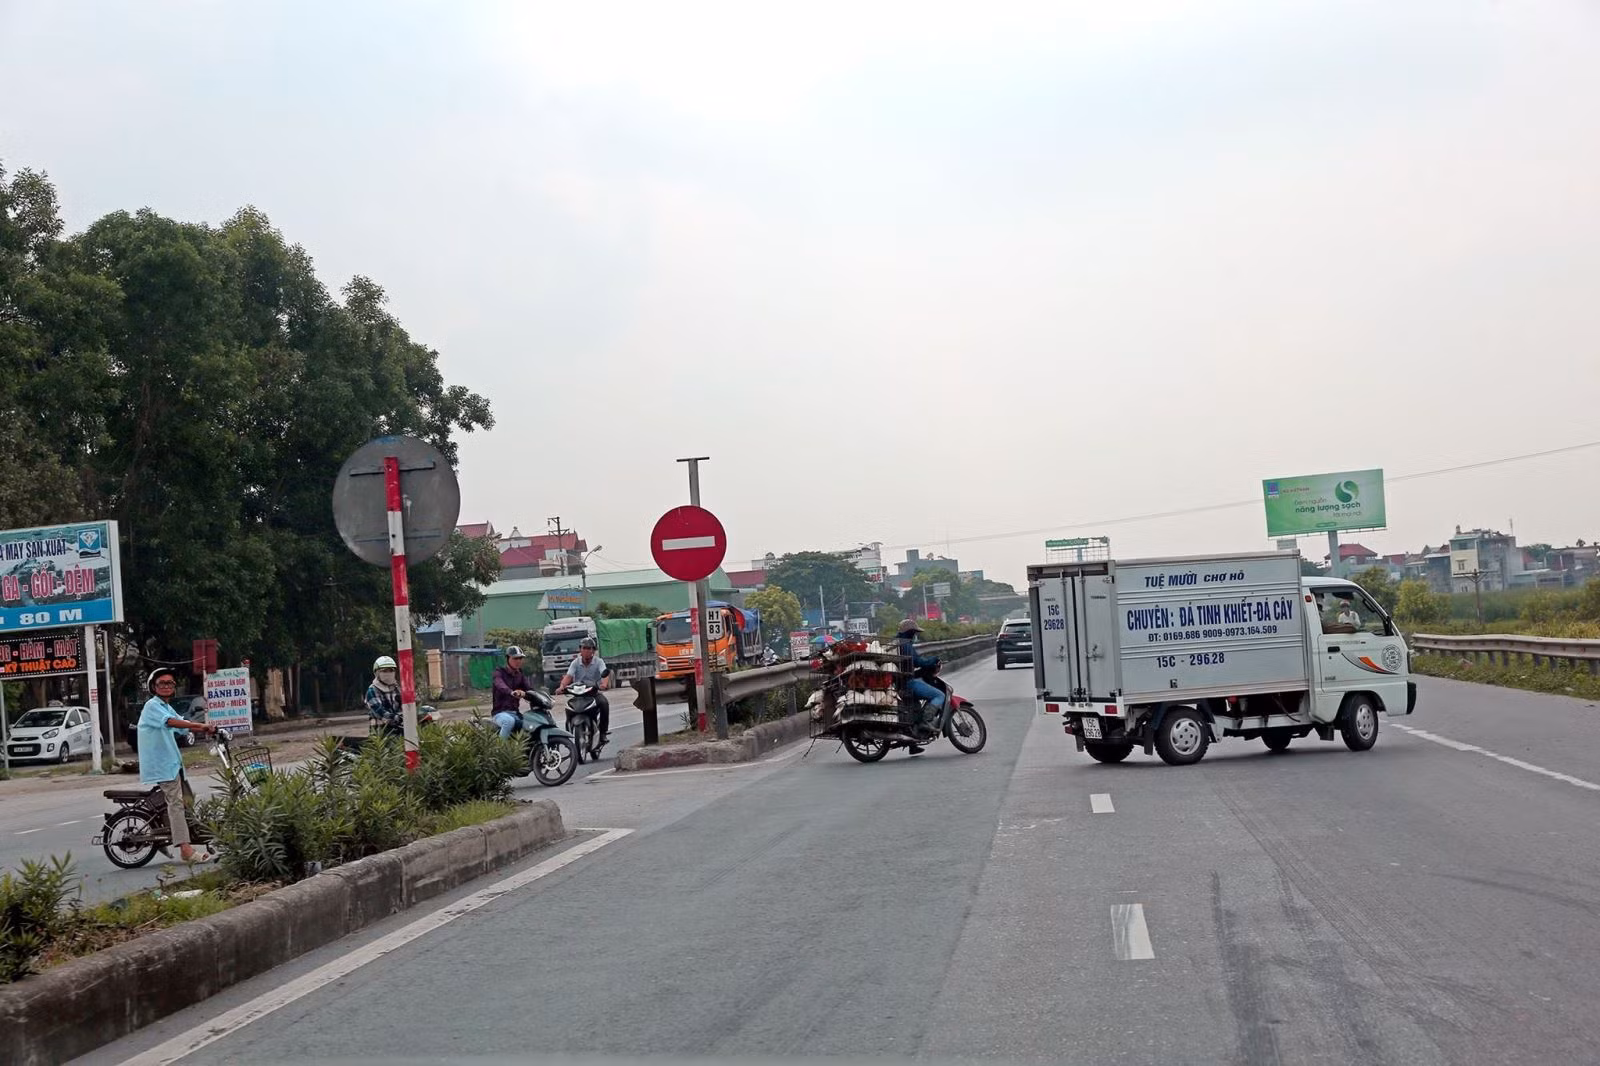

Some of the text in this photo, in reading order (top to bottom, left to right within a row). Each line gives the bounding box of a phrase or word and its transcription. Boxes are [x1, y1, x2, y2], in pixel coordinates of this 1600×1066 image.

[2, 574, 20, 601] GA
[64, 563, 95, 600] ĐỆM
[1145, 573, 1165, 589] TUỆ
[1168, 570, 1197, 586] MƯỜI
[1203, 572, 1227, 583] CHỢ
[19, 611, 50, 625] 80
[59, 608, 82, 622] M
[709, 611, 719, 620] H1
[1047, 605, 1060, 616] 15C
[1179, 602, 1195, 627] ĐÁ
[1197, 604, 1221, 626] TINH
[1273, 597, 1293, 620] CÂY
[709, 625, 721, 634] 83
[1043, 619, 1065, 631] 29628
[52, 658, 77, 669] CAO
[1157, 655, 1176, 668] 15C
[208, 688, 247, 699] BÁNH ĐA
